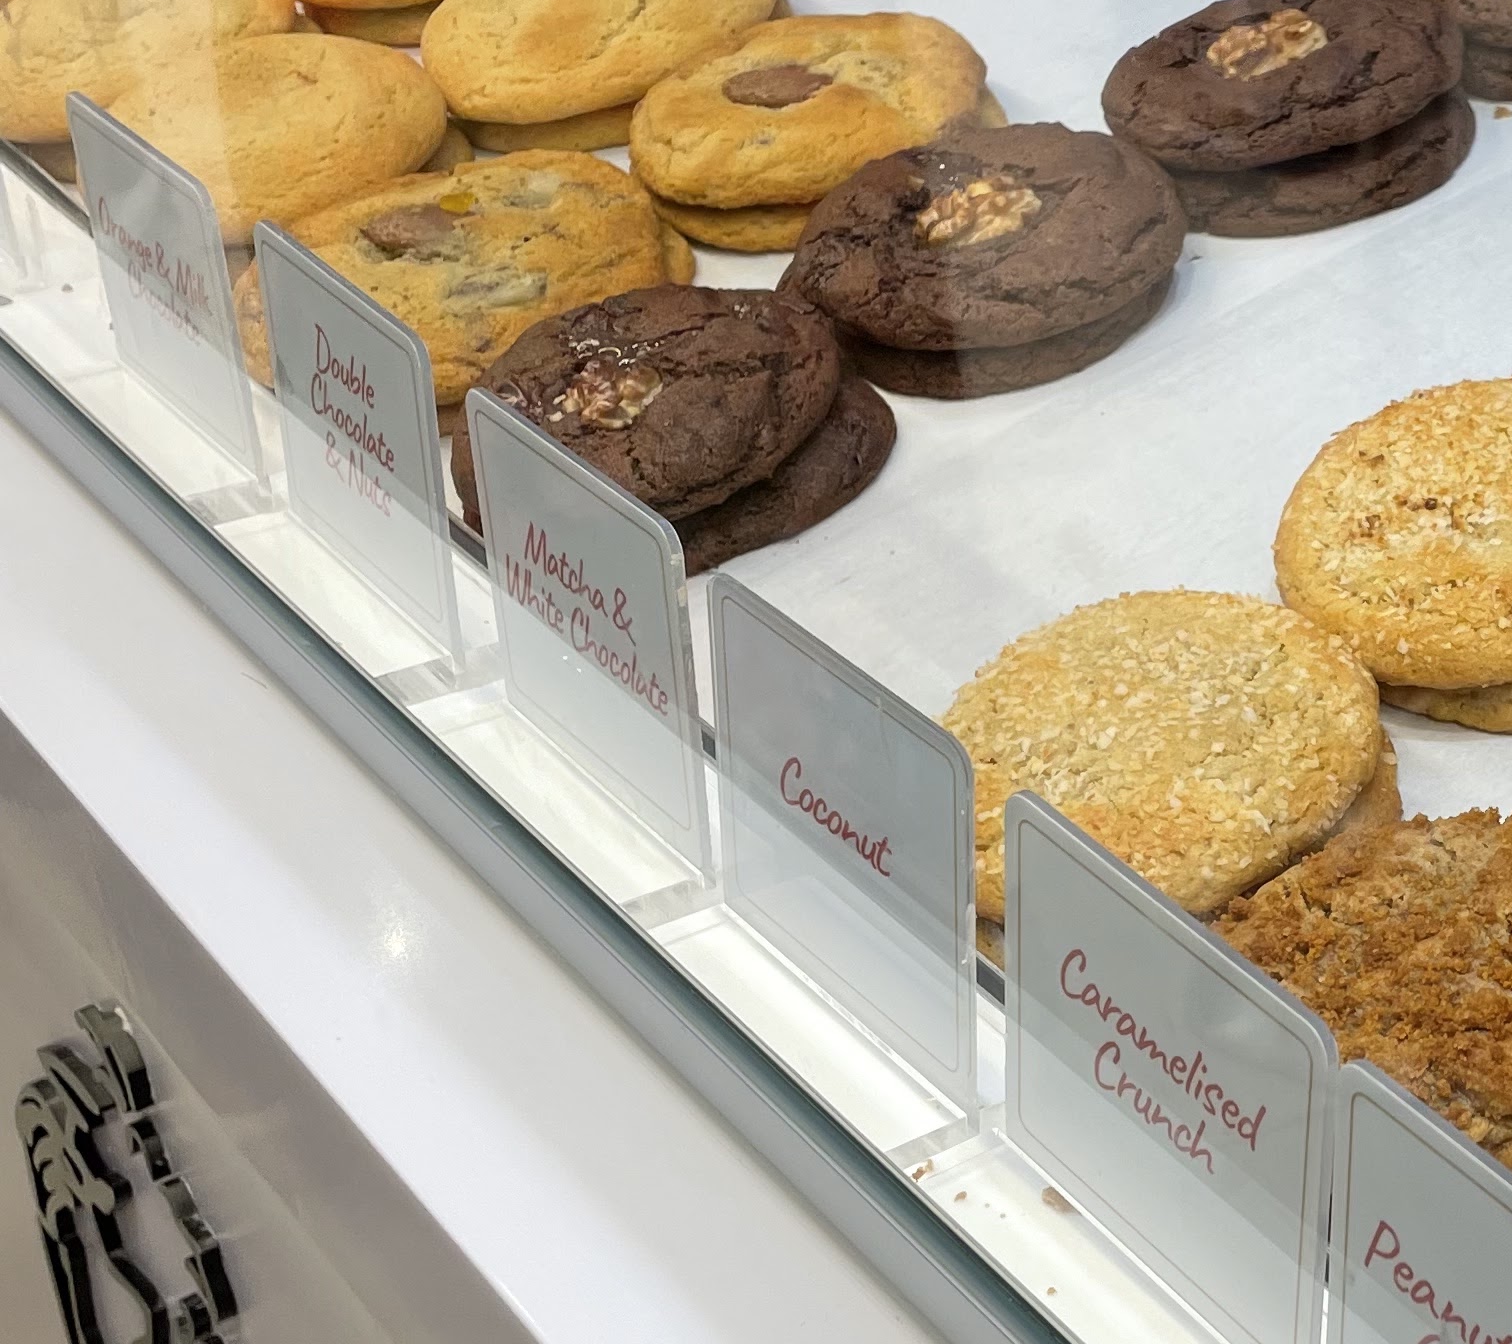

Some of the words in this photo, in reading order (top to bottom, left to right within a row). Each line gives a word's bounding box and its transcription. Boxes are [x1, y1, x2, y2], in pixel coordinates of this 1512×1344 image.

[156, 241, 174, 290] &
[177, 258, 213, 316] Milk
[312, 373, 394, 472] Chocolate
[315, 323, 375, 409] Double
[326, 431, 345, 482] &
[349, 449, 391, 517] Nuts
[506, 554, 563, 633] White
[571, 608, 667, 716] Chocolate
[525, 521, 608, 617] Matcha
[613, 588, 636, 646] &
[780, 757, 892, 877] Coconut
[1061, 949, 1266, 1151] Caramelised
[1095, 1041, 1214, 1174] Crunch
